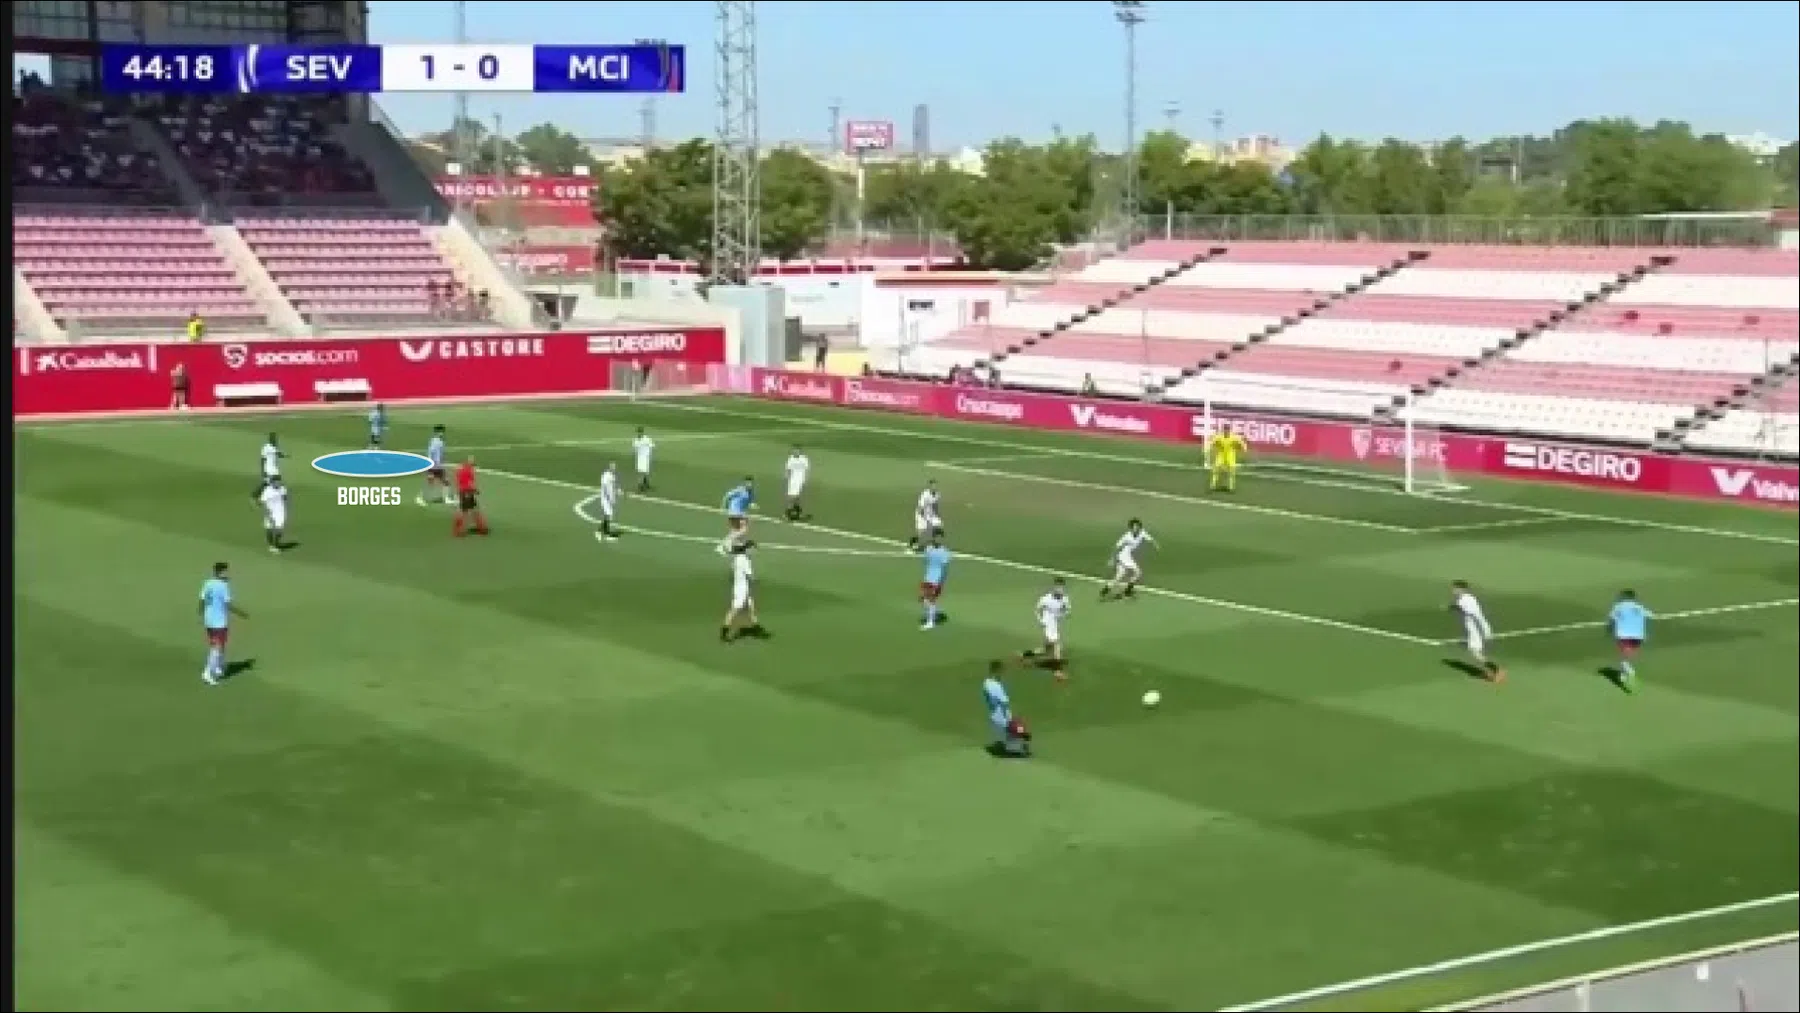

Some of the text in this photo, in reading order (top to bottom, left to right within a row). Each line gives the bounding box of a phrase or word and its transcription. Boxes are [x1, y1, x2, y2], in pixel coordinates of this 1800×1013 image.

[438, 338, 545, 360] CASTORE
[613, 333, 687, 352] DEGIRO
[1537, 446, 1642, 482] DEGIRO
